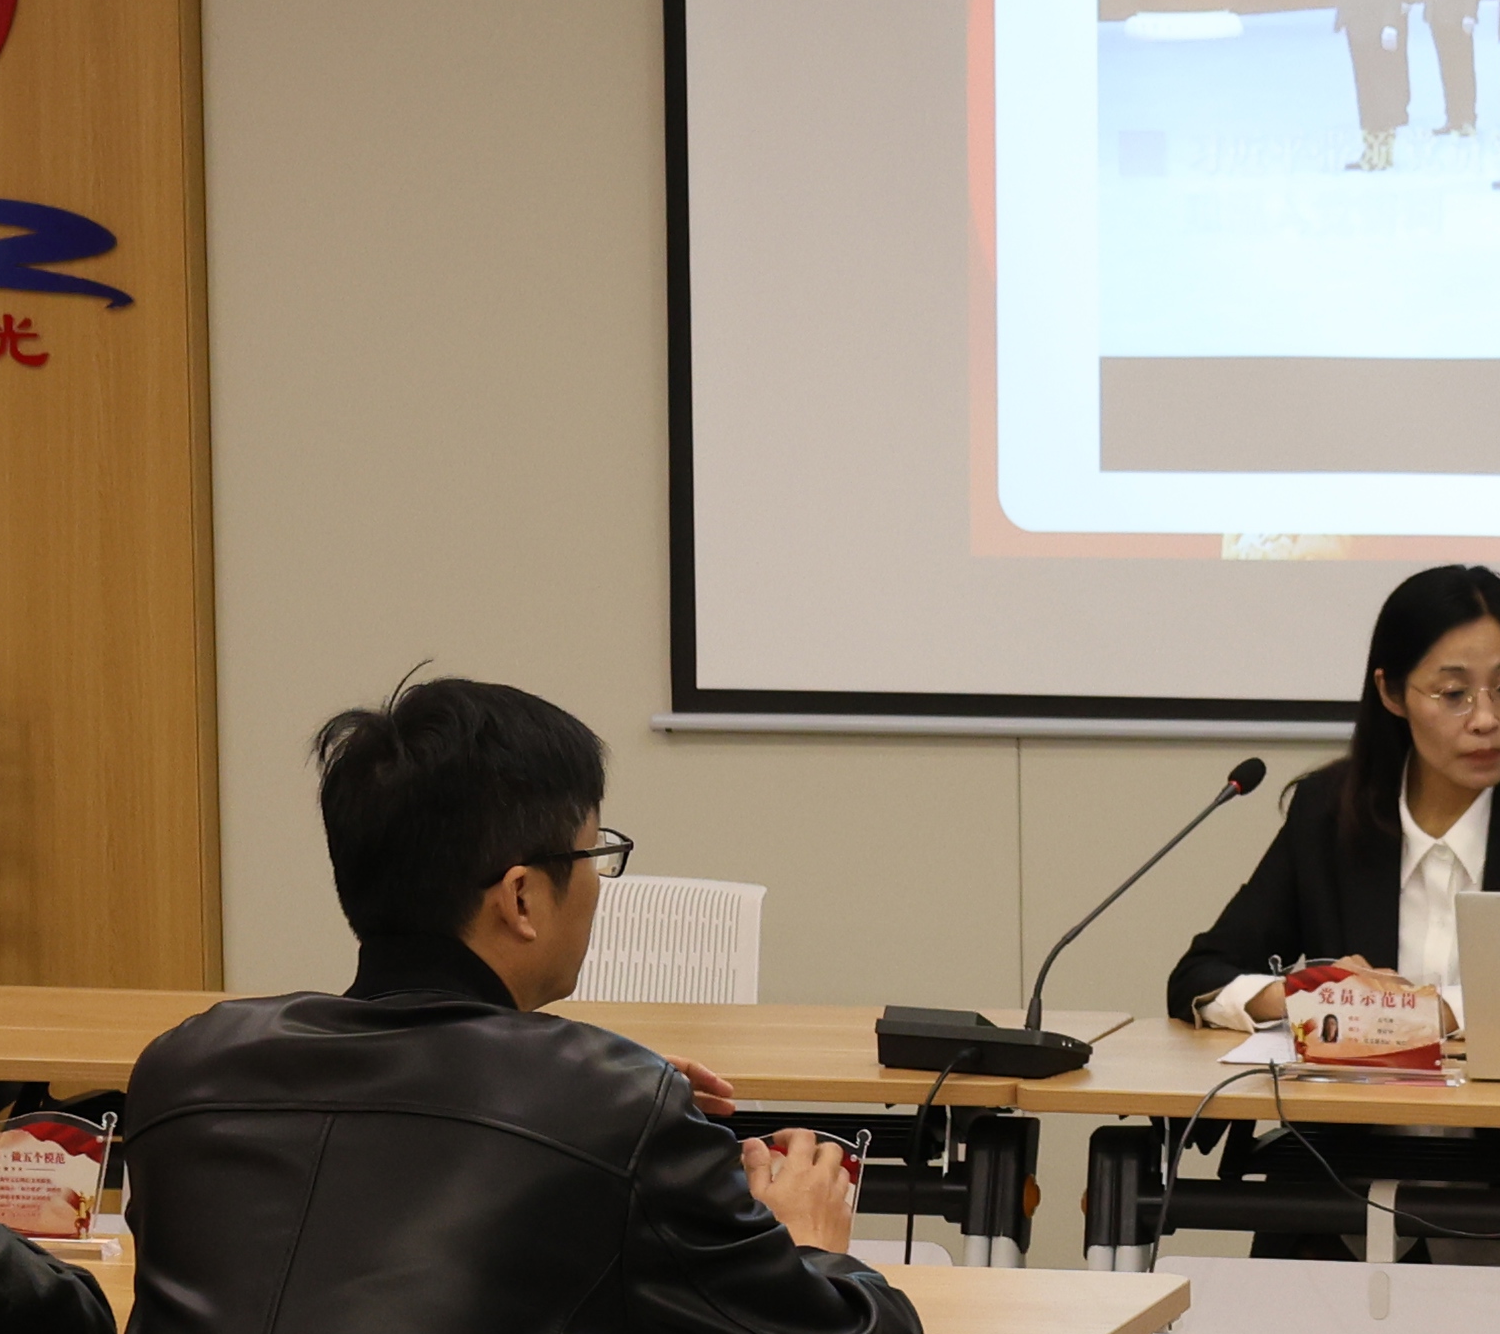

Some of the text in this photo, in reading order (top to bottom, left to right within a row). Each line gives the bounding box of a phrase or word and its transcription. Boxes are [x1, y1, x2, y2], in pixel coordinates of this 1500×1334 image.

[1318, 987, 1417, 1010] 党员示范岗
